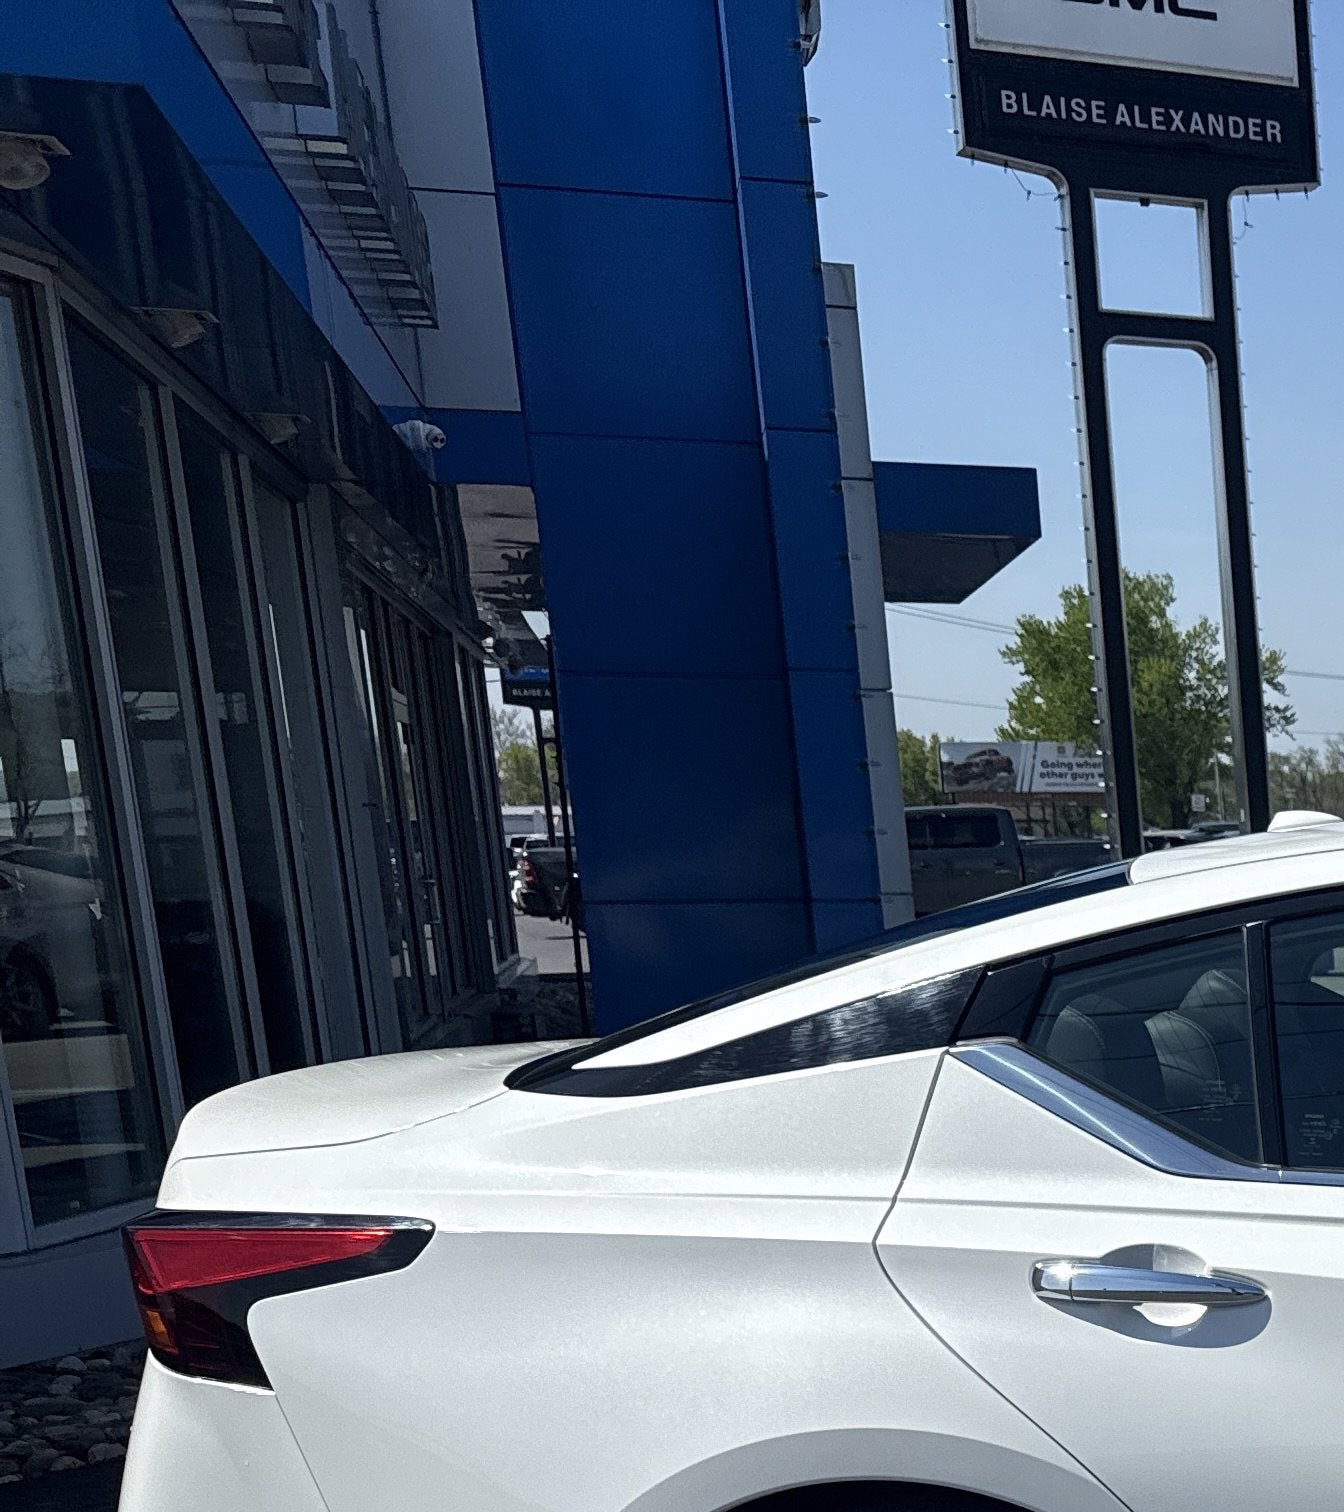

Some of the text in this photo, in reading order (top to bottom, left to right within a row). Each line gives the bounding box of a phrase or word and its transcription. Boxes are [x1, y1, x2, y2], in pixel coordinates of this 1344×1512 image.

[1000, 90, 1282, 143] BLAISE ALEXANDER
[1040, 759, 1103, 771] Going wher
[1039, 770, 1069, 779] other
[1070, 771, 1095, 781] guys
